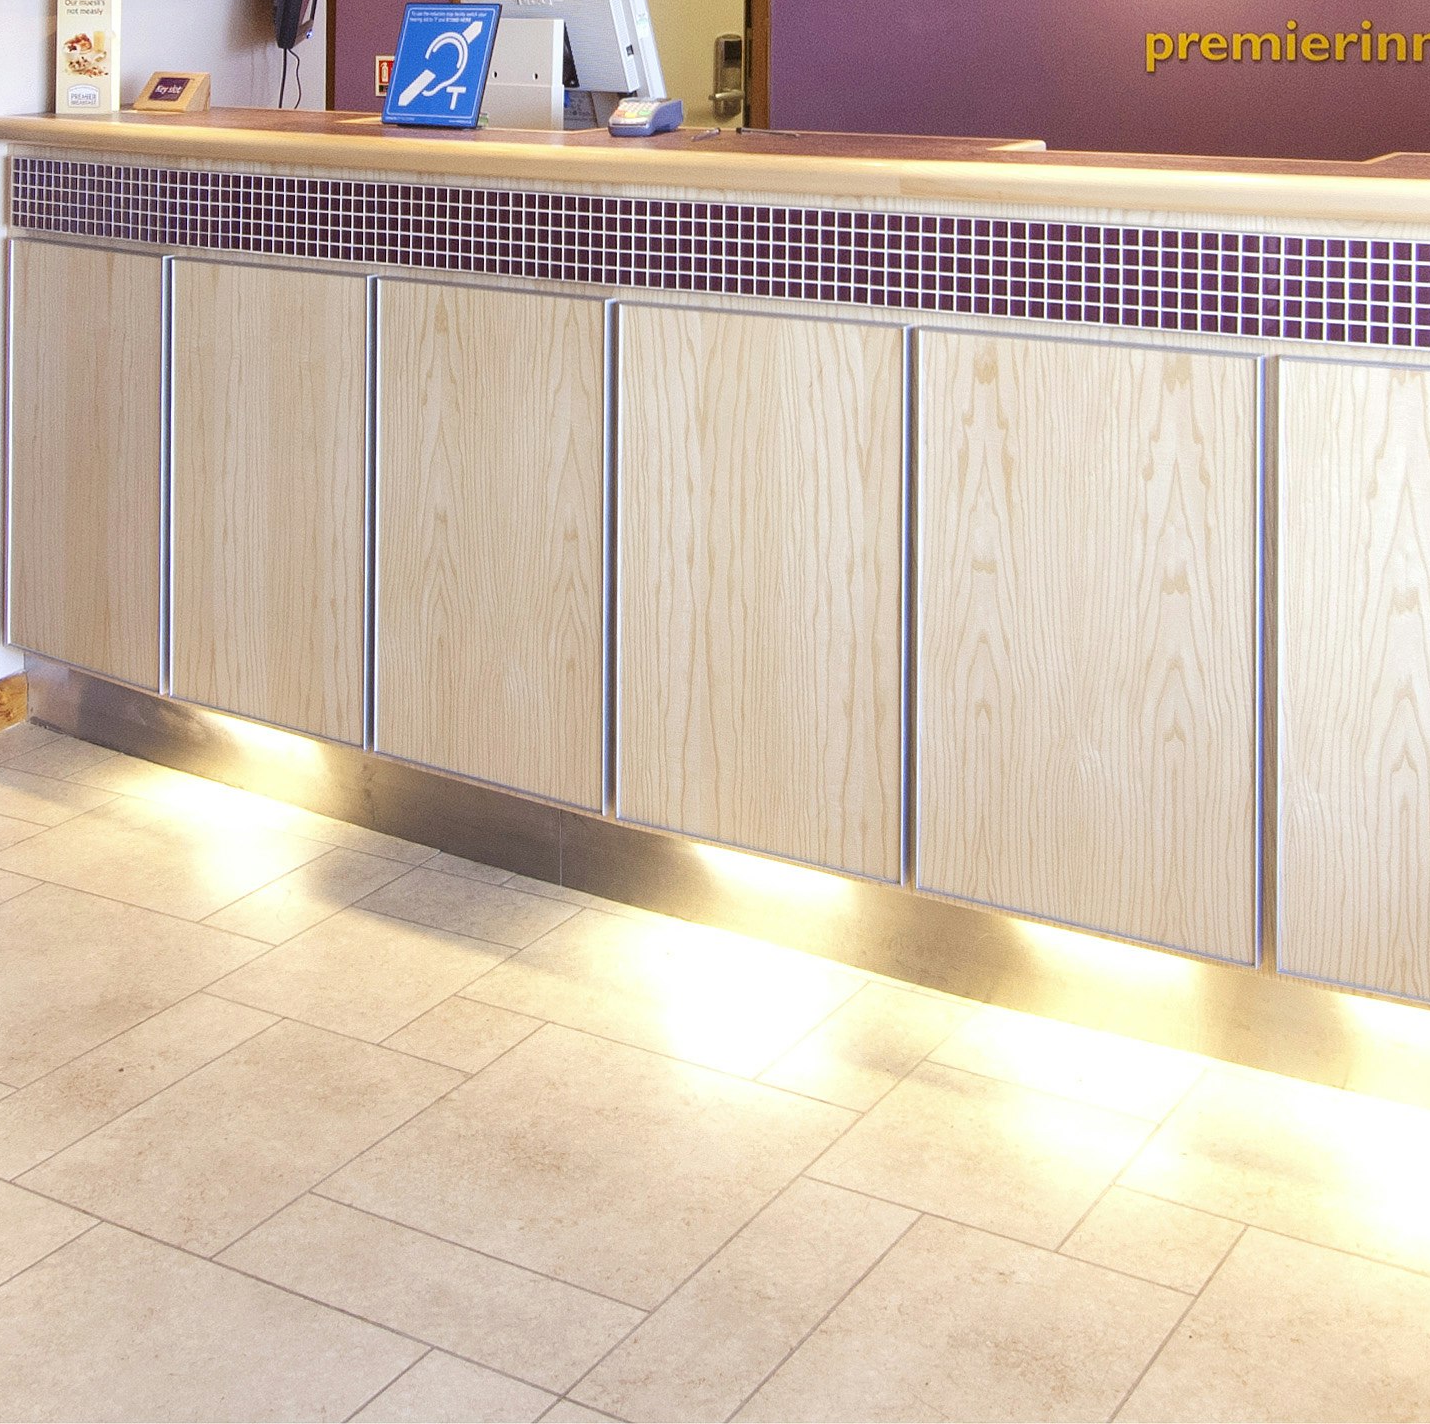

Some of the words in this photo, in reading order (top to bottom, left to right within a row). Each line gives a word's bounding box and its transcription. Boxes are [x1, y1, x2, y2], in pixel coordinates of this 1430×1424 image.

[80, 8, 103, 16] measly
[156, 84, 168, 95] Key
[168, 85, 183, 94] slot
[446, 87, 467, 111] T
